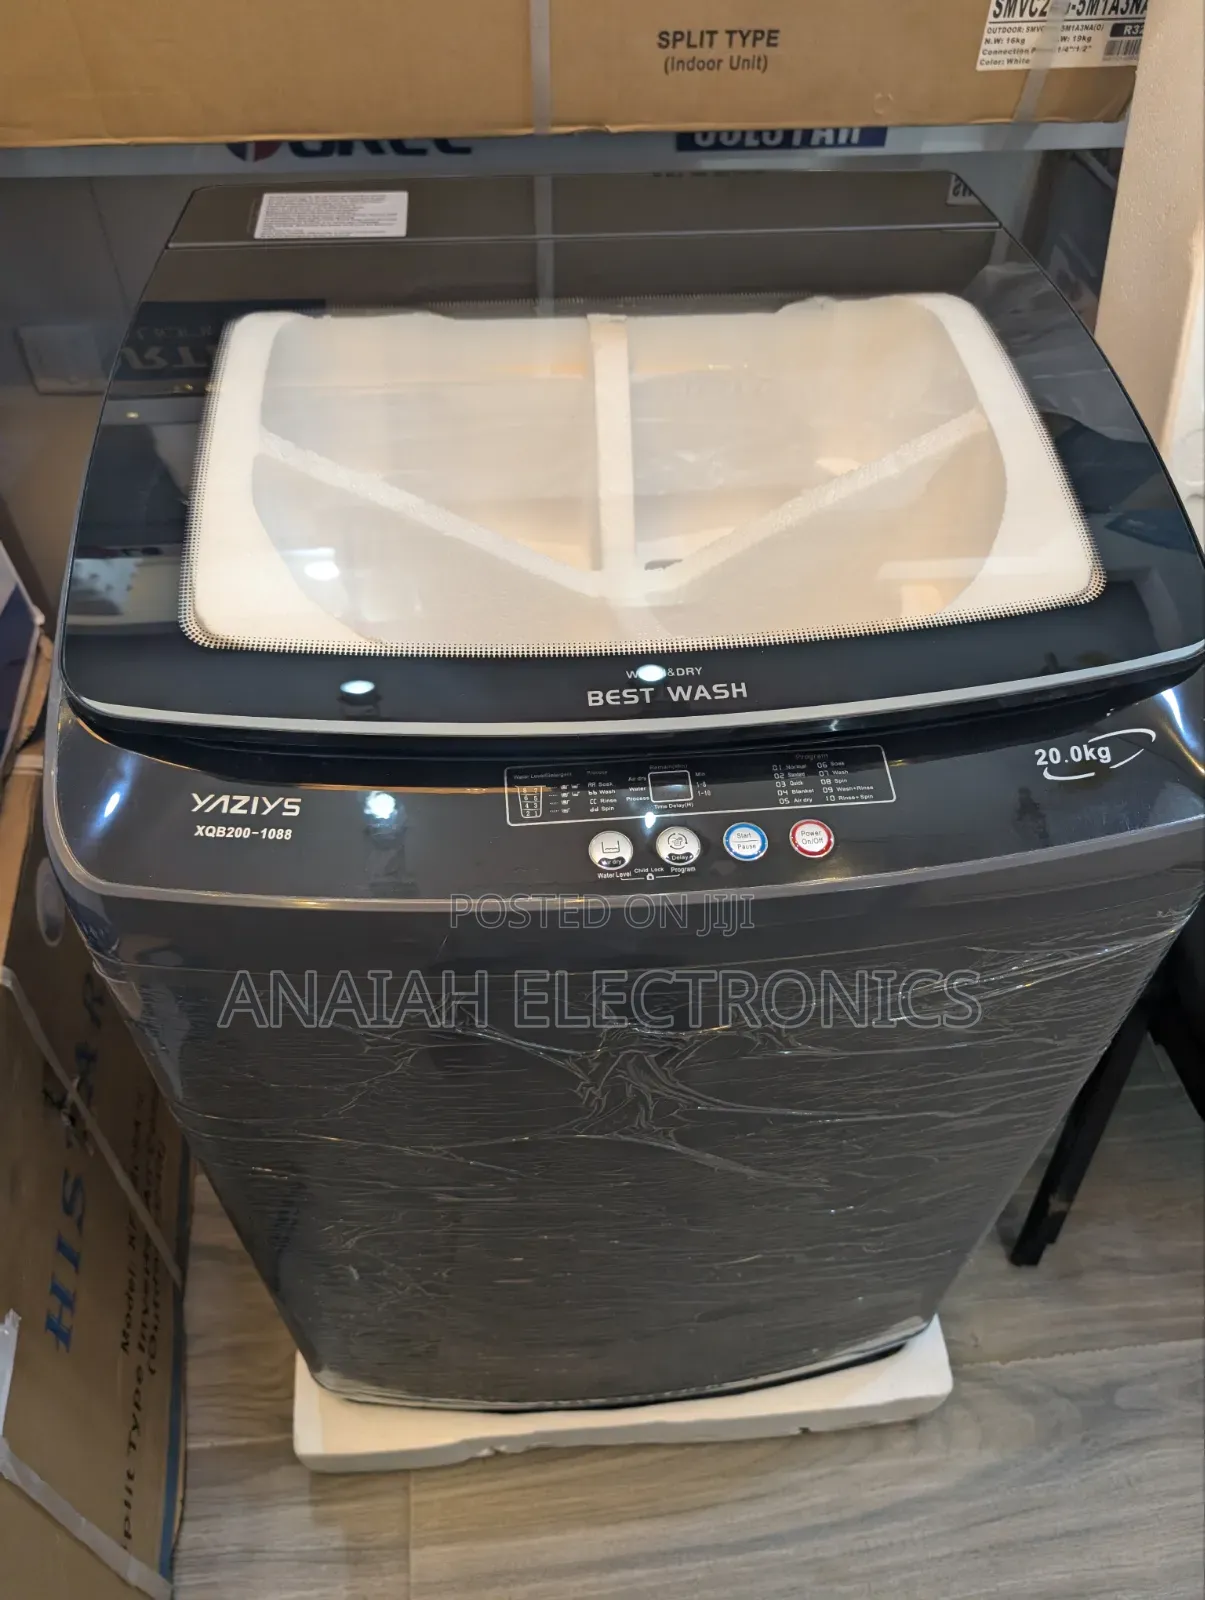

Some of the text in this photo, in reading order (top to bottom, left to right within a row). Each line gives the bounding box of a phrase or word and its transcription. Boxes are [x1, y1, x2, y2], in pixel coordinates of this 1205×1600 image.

[657, 29, 780, 49] SPLIT TYPE
[664, 55, 768, 76] (Indoor Unit)
[587, 682, 748, 707] BEST WASH
[1034, 744, 1112, 766] 20.0kg
[816, 761, 828, 769] 06
[773, 772, 785, 780] 02
[822, 786, 834, 794] 09
[190, 792, 302, 817] YAZIYS
[778, 797, 790, 805] 05
[193, 824, 293, 841] XQB200-1088
[671, 854, 689, 862] Delay
[670, 866, 696, 874] Program
[597, 871, 615, 879] Water
